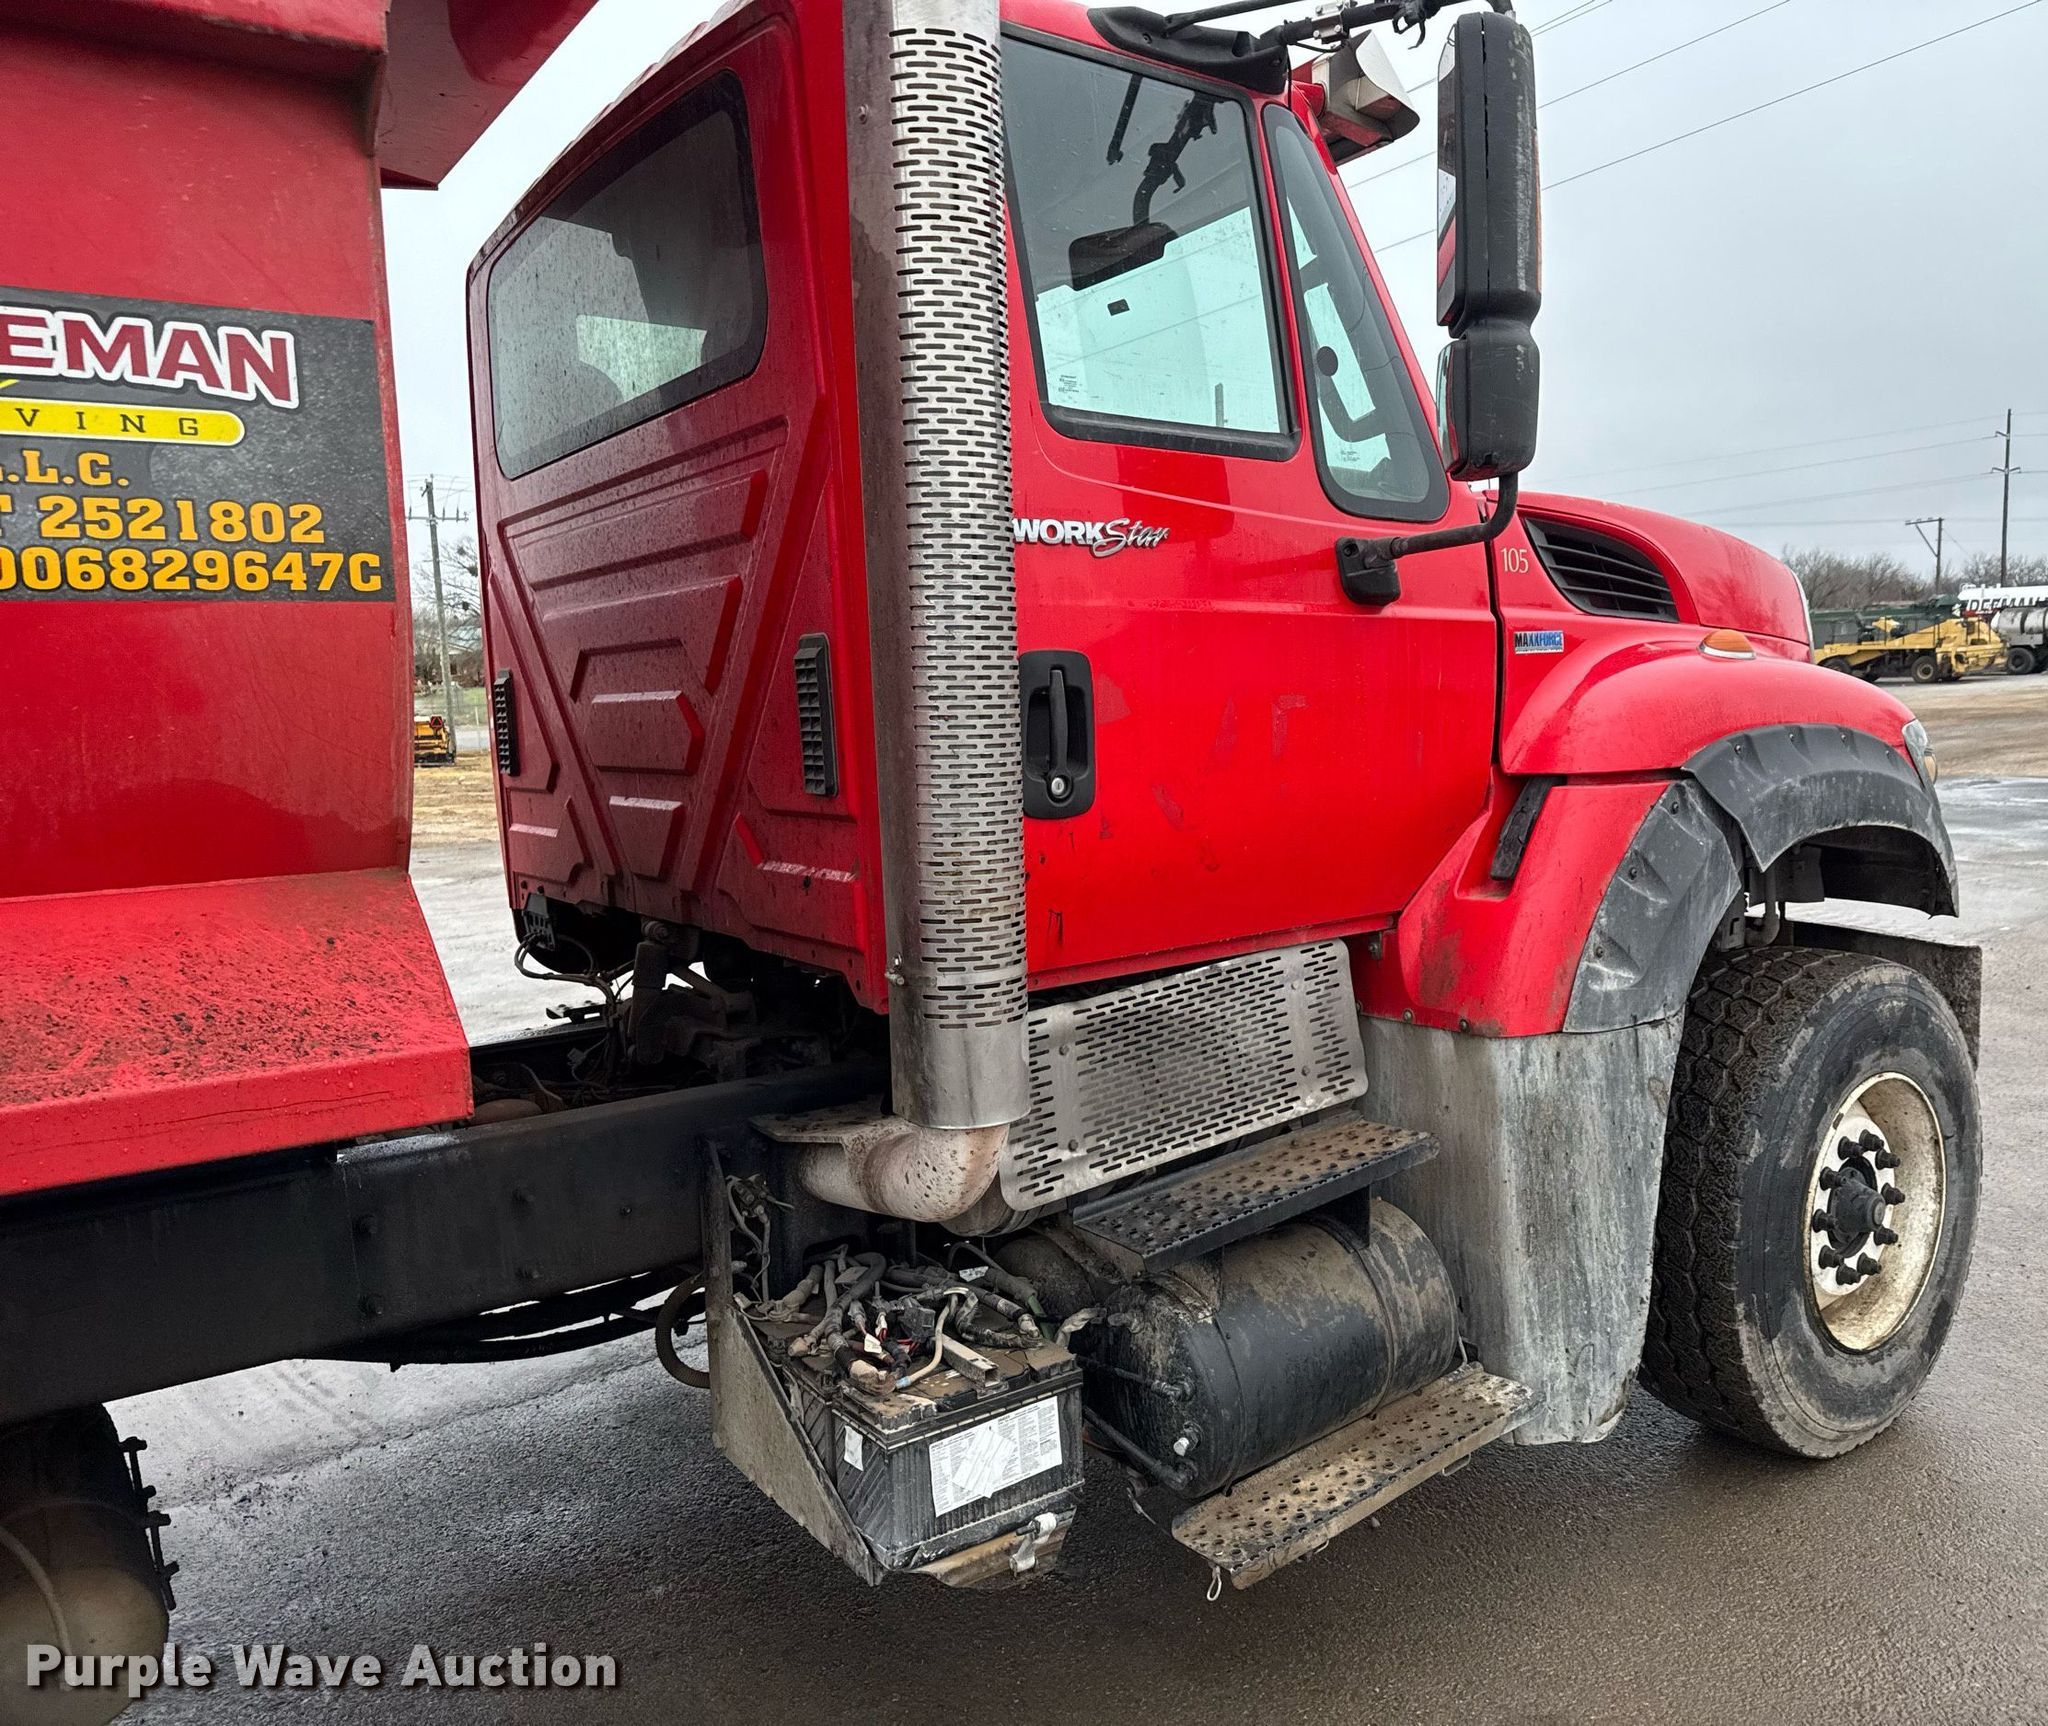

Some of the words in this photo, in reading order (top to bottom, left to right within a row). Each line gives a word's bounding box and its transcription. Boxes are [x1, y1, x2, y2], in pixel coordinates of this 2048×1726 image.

[0, 308, 298, 408] EMAN
[15, 408, 199, 436] VING
[0, 450, 129, 486] .L.C.
[39, 494, 324, 543] 2521802
[1501, 548, 1529, 573] 105
